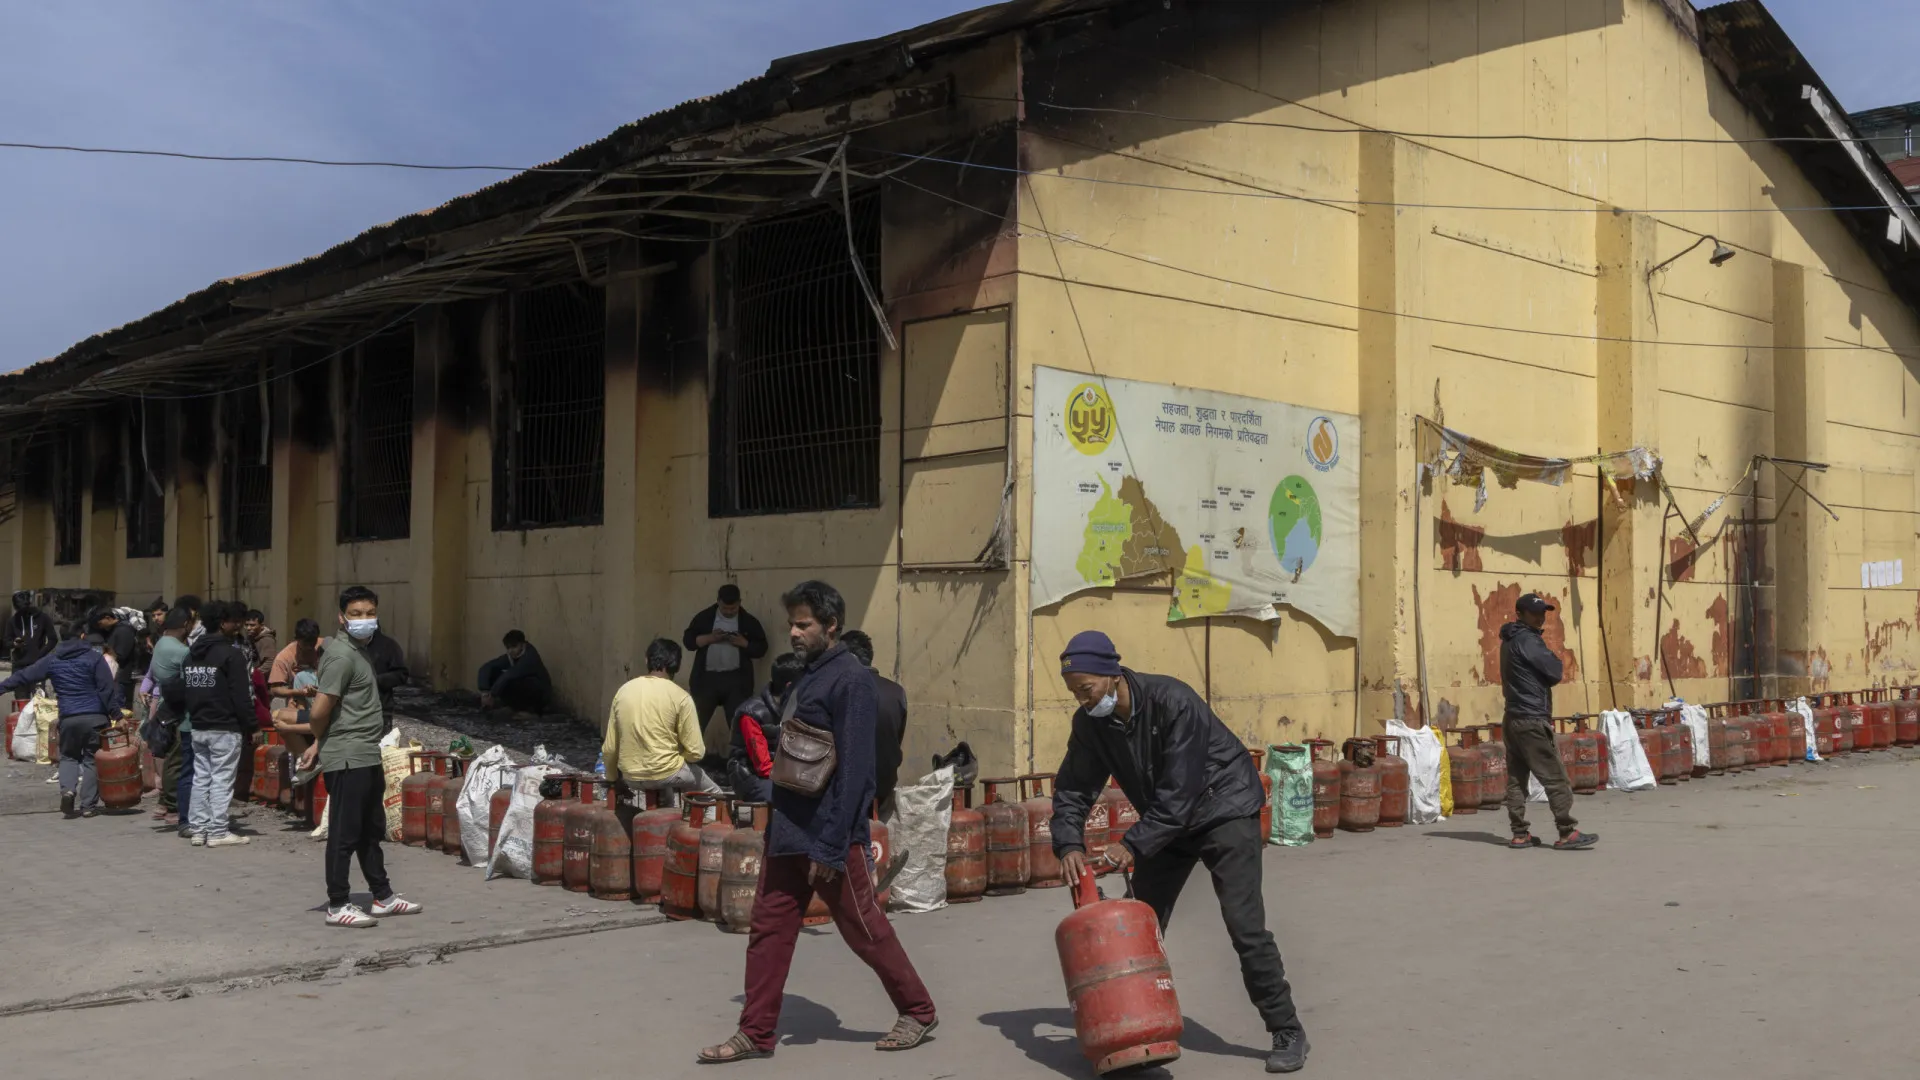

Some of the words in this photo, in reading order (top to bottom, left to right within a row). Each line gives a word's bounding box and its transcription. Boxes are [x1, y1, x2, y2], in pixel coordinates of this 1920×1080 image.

[1162, 402, 1192, 420] सहजता,
[1196, 406, 1217, 422] शुद्धता
[1221, 410, 1226, 421] र
[1230, 410, 1262, 426] पारदर्शिता
[1155, 416, 1175, 433] नेपाल
[1180, 423, 1201, 436] आयल
[1205, 422, 1233, 440] निगमको
[185, 666, 206, 674] CLASS
[206, 666, 217, 674] OF
[185, 673, 216, 688] 2025
